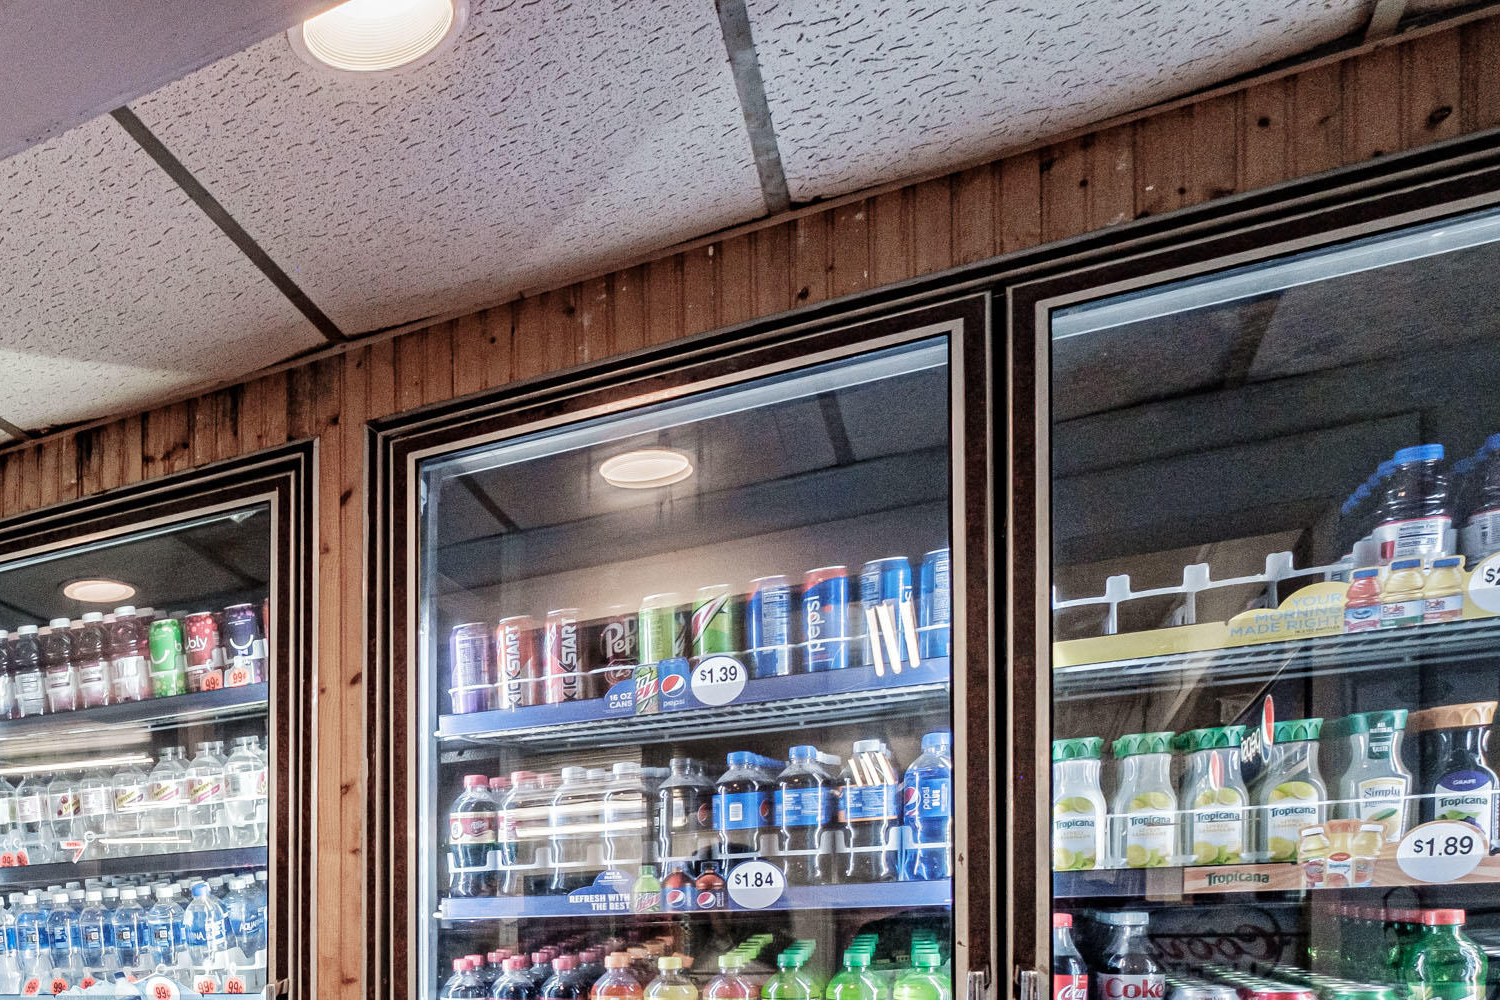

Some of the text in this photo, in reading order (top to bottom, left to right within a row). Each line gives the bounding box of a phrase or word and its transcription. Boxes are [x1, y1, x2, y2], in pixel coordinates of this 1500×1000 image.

[1291, 592, 1342, 608] YOUR
[1425, 600, 1446, 609] Dole
[1254, 606, 1342, 623] MORNING
[1382, 604, 1405, 613] Dole
[807, 595, 826, 653] pepsi
[1230, 623, 1281, 638] MADE
[1285, 616, 1341, 631] RIGHT
[561, 618, 578, 701] KICKSTART
[700, 667, 738, 684] $1.39
[620, 692, 633, 700] OZ
[663, 699, 686, 707] pepsi
[610, 700, 633, 709] CANS
[1452, 777, 1477, 786] GRAPE
[923, 786, 932, 810] pepsi
[932, 788, 941, 807] BLUE
[1439, 796, 1488, 808] Tropicana
[1196, 811, 1241, 823] Tropicana
[1270, 805, 1317, 819] Tropicana
[1055, 818, 1095, 830] Tropicana
[1129, 816, 1171, 827] Tropicana
[1413, 835, 1474, 857] $1.89
[734, 871, 774, 888] $1.84
[1205, 871, 1270, 887] Tropicana
[569, 893, 630, 904] REFRESH WITH
[592, 902, 609, 911] THE
[609, 901, 631, 911] BEST
[155, 986, 171, 1000] 99¢
[1105, 977, 1165, 999] Coke
